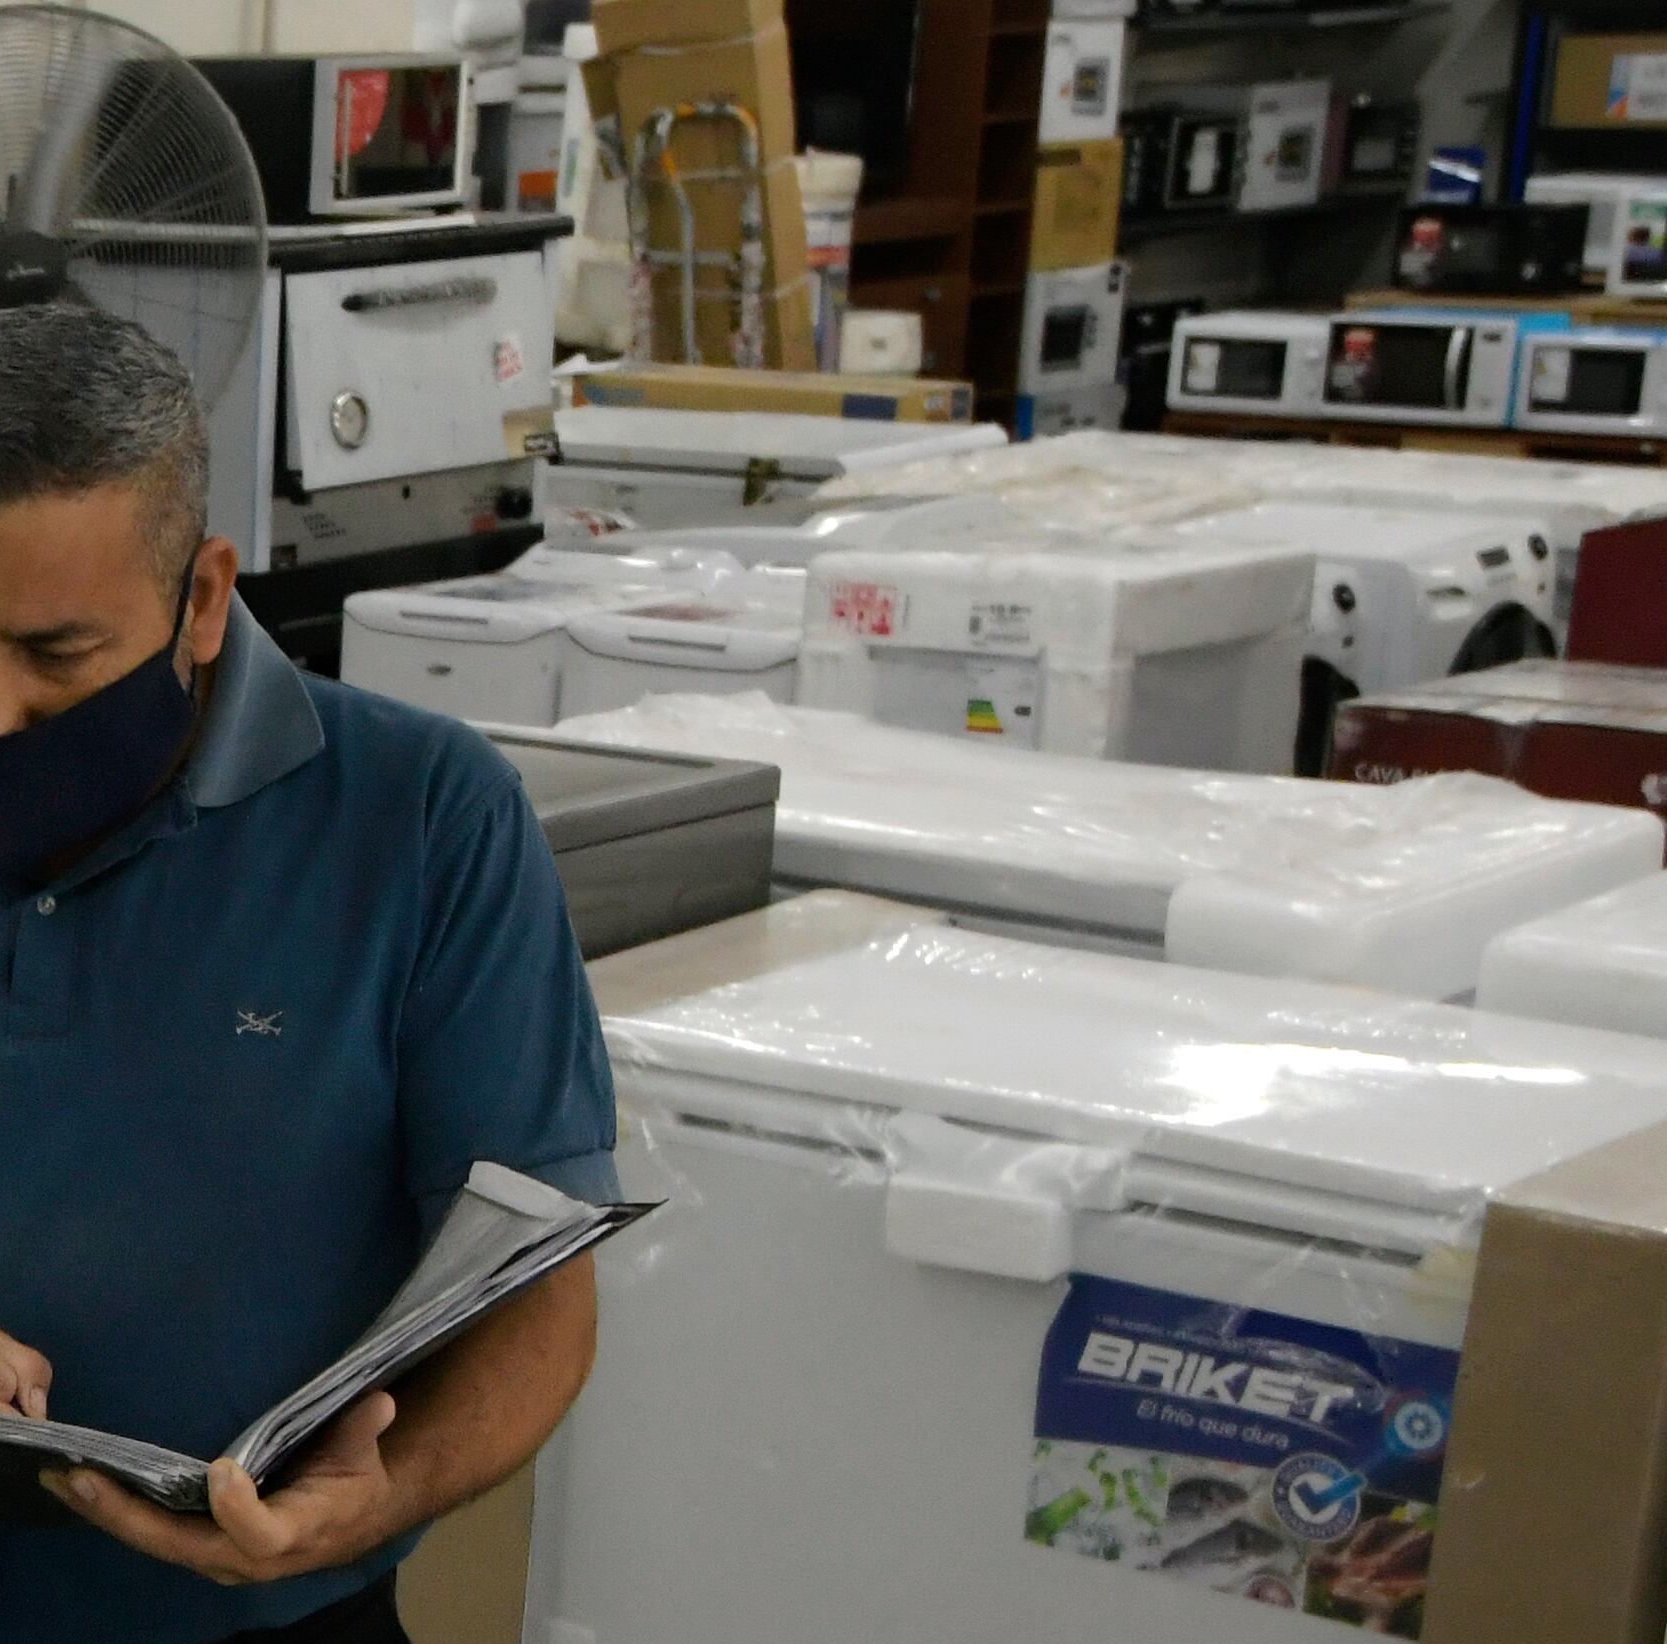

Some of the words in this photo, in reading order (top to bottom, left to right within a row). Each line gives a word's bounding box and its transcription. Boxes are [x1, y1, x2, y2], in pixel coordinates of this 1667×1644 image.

[1077, 1332, 1354, 1423] BRIKET
[1198, 1417, 1237, 1437] que
[1242, 1425, 1289, 1450] dura
